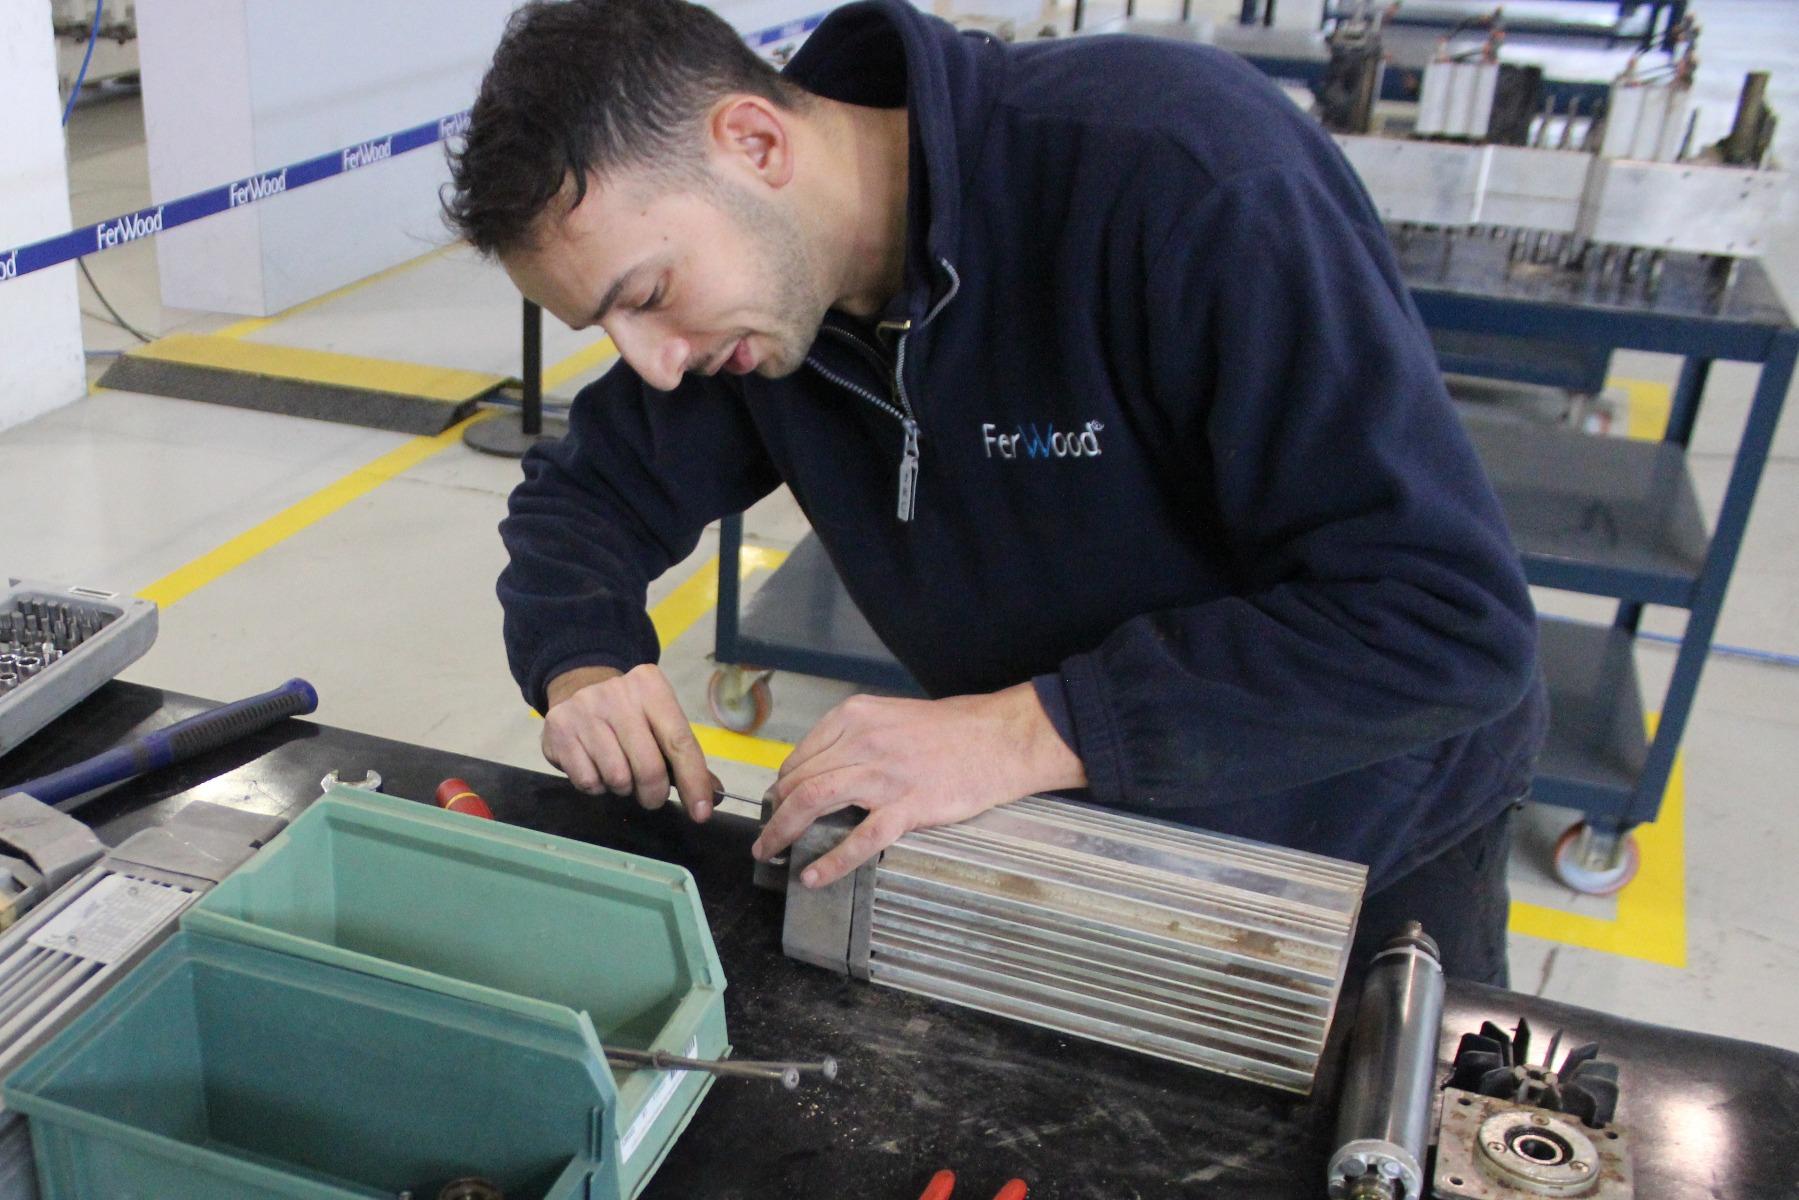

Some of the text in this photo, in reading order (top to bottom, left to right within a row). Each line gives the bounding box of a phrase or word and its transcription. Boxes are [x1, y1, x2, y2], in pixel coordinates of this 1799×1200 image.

[97, 205, 163, 249] FerWood
[230, 167, 287, 207] FerWood
[343, 135, 392, 171] FerWood
